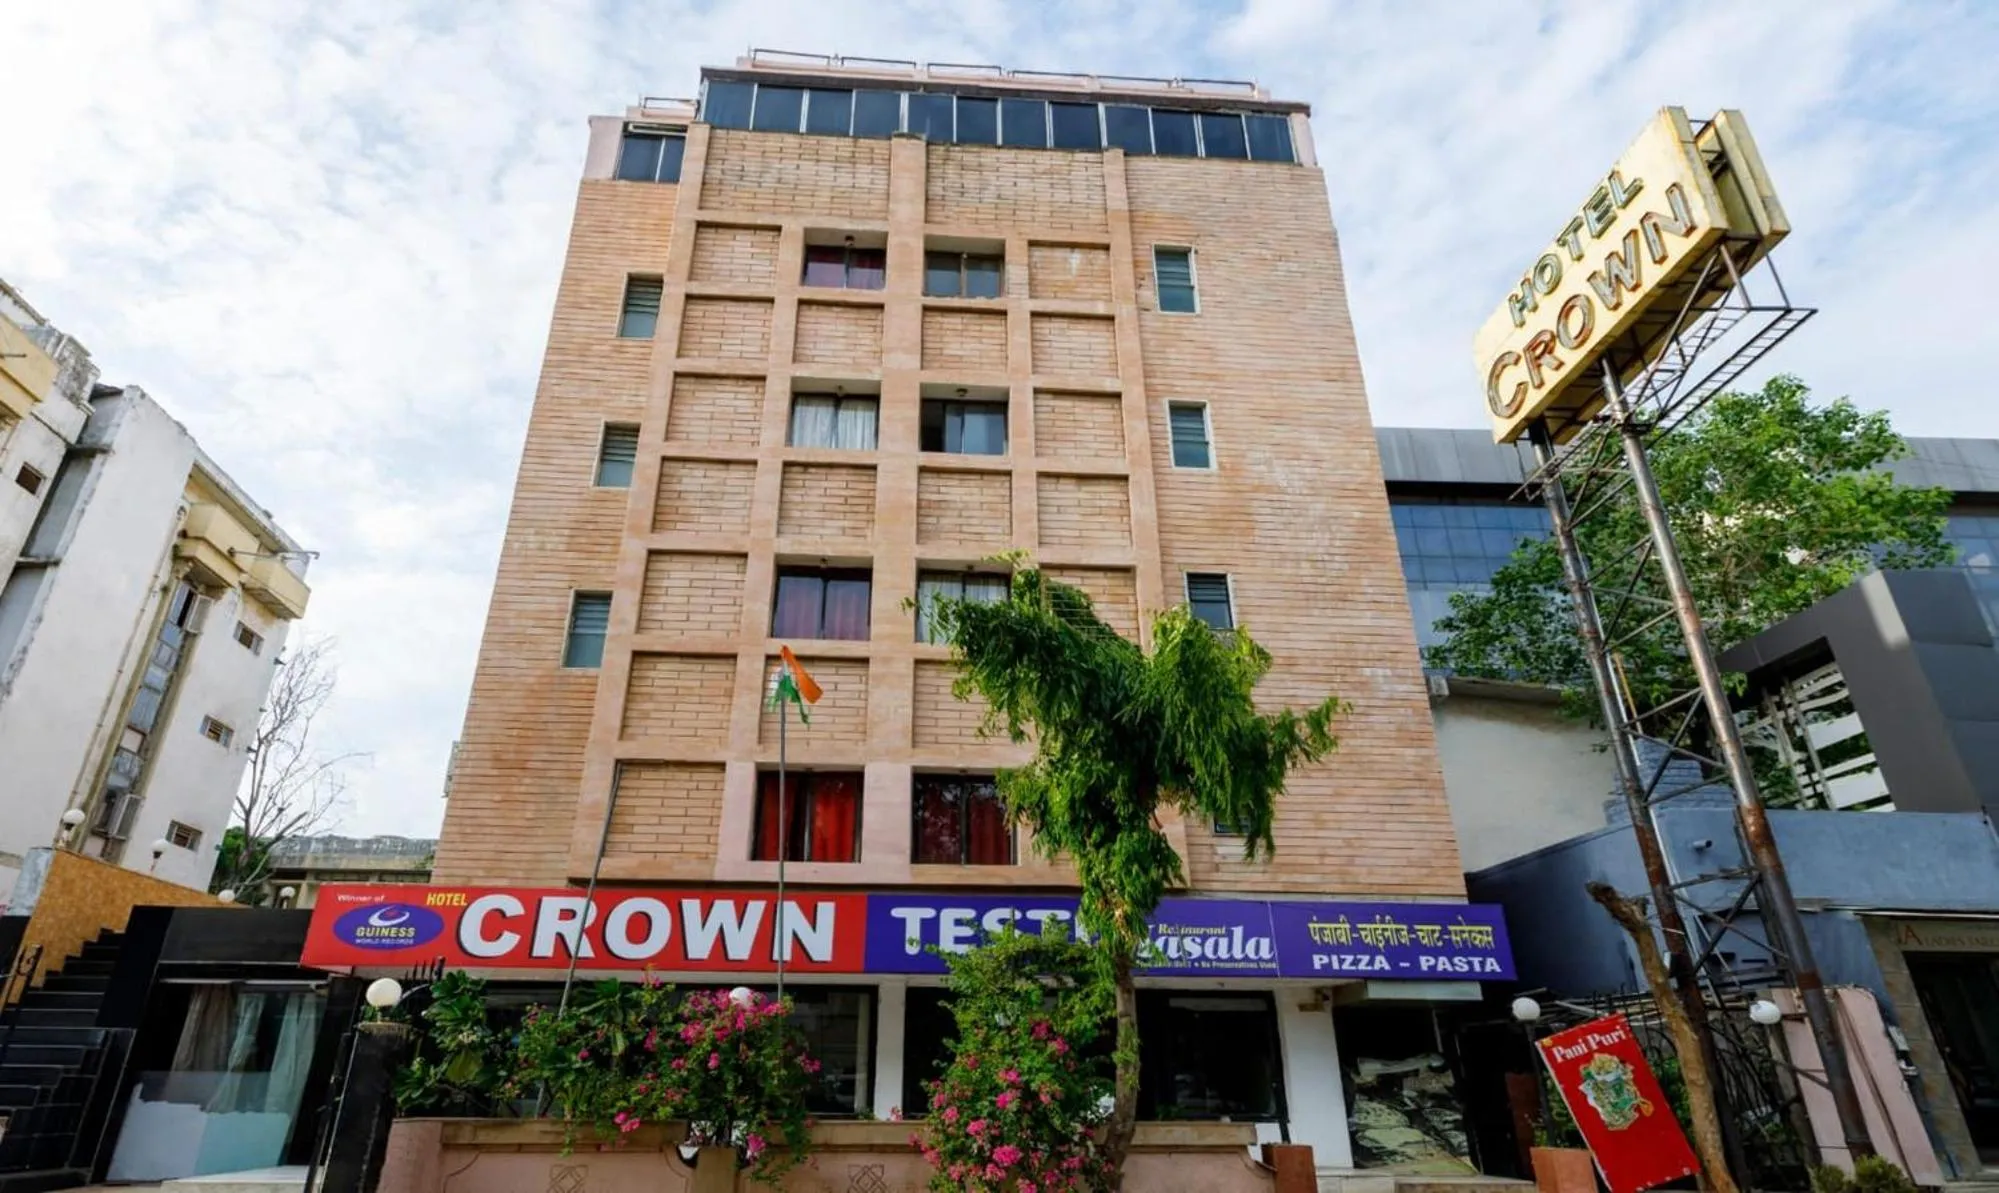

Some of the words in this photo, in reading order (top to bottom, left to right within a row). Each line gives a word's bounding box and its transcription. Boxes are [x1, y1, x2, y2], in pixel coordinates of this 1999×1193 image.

[1507, 169, 1645, 328] HOTEL
[1487, 181, 1698, 419] CROWN
[337, 894, 372, 902] Winner
[374, 893, 385, 902] of
[426, 892, 468, 906] HOTEL
[356, 926, 416, 938] GUINESS
[457, 894, 836, 962] CROWN
[1312, 954, 1391, 971] PIZZA
[1419, 956, 1502, 973] PASTA
[1552, 1038, 1588, 1063] Pani
[1587, 1025, 1626, 1050] Puri
